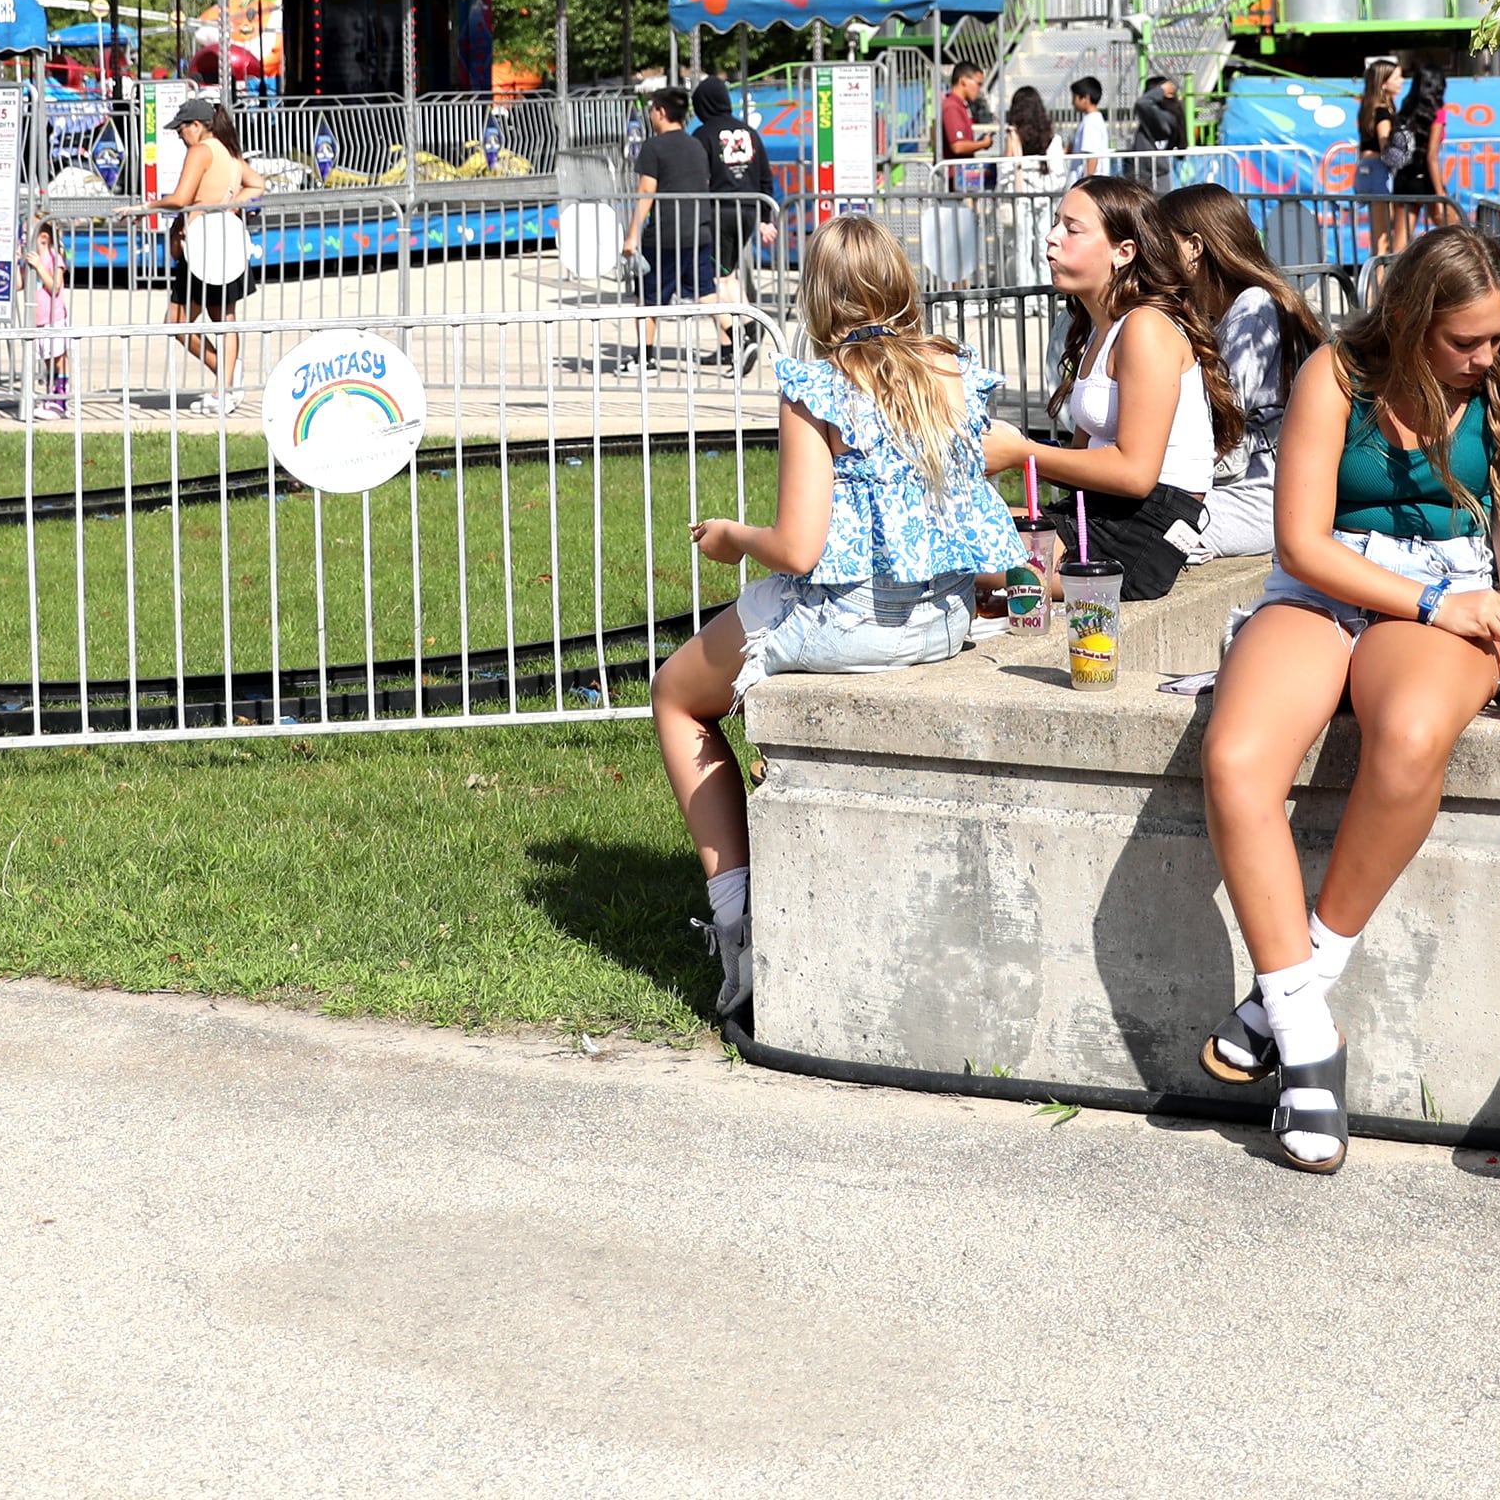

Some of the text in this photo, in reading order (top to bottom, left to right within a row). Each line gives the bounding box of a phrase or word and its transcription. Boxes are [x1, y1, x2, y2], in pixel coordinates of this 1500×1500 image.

[818, 90, 832, 130] YES
[718, 128, 754, 165] 23
[291, 349, 387, 400] FANTASY
[1022, 616, 1042, 628] 1901
